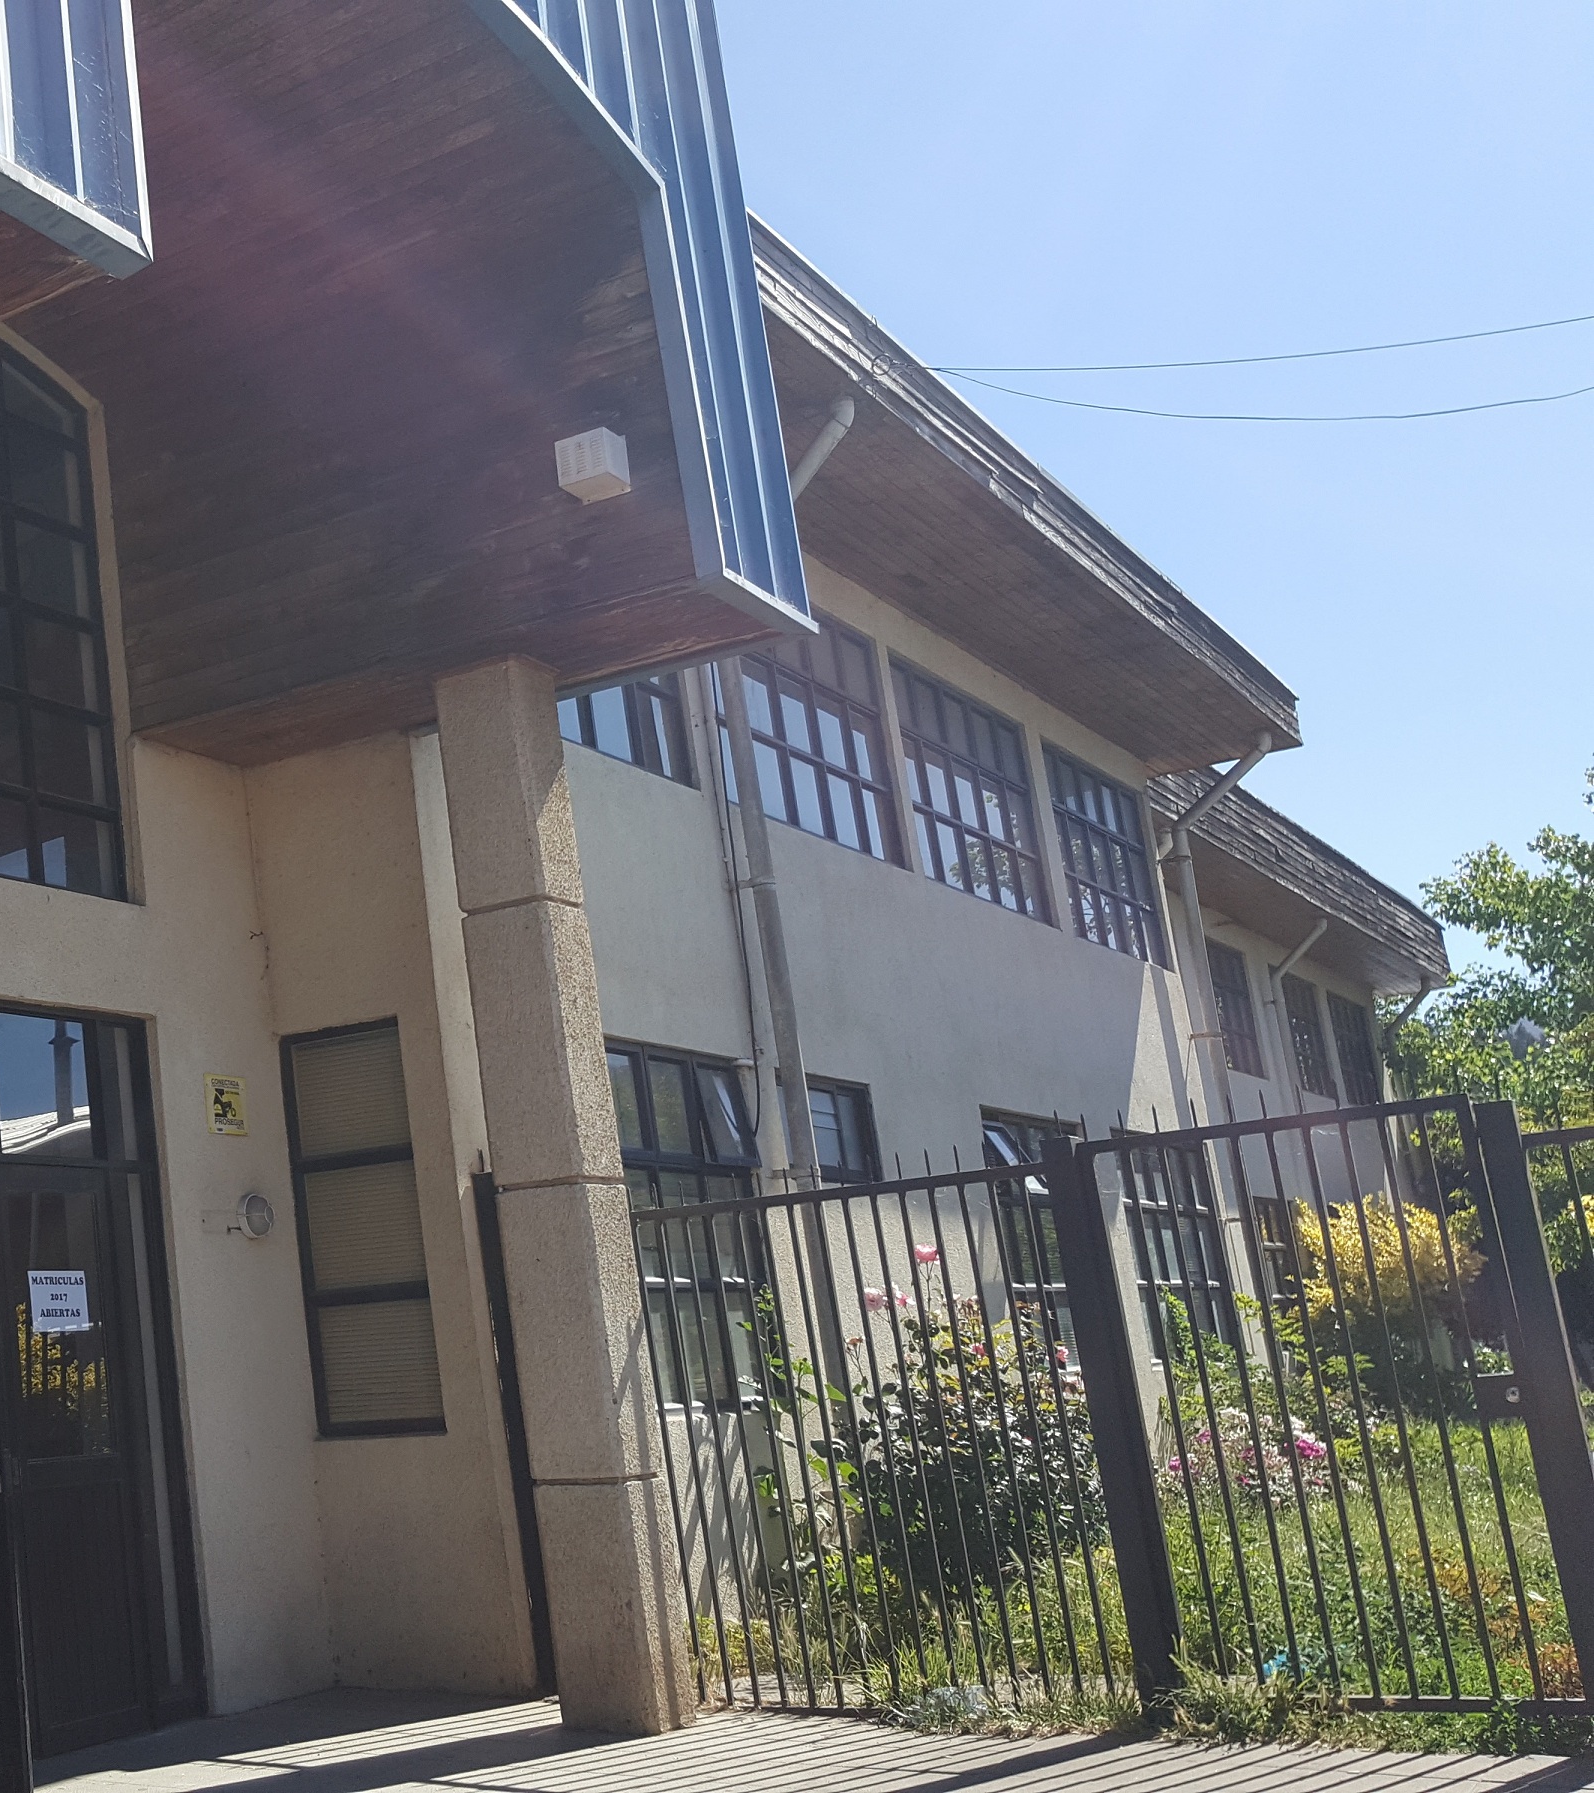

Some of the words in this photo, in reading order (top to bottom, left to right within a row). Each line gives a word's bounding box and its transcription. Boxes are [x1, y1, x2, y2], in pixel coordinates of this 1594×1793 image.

[211, 1078, 239, 1086] CONECTADA
[214, 1118, 244, 1126] PROSEGUR
[31, 1276, 84, 1286] MATRICULAS
[50, 1293, 68, 1302] 2017
[40, 1308, 81, 1318] ABIERTAS
